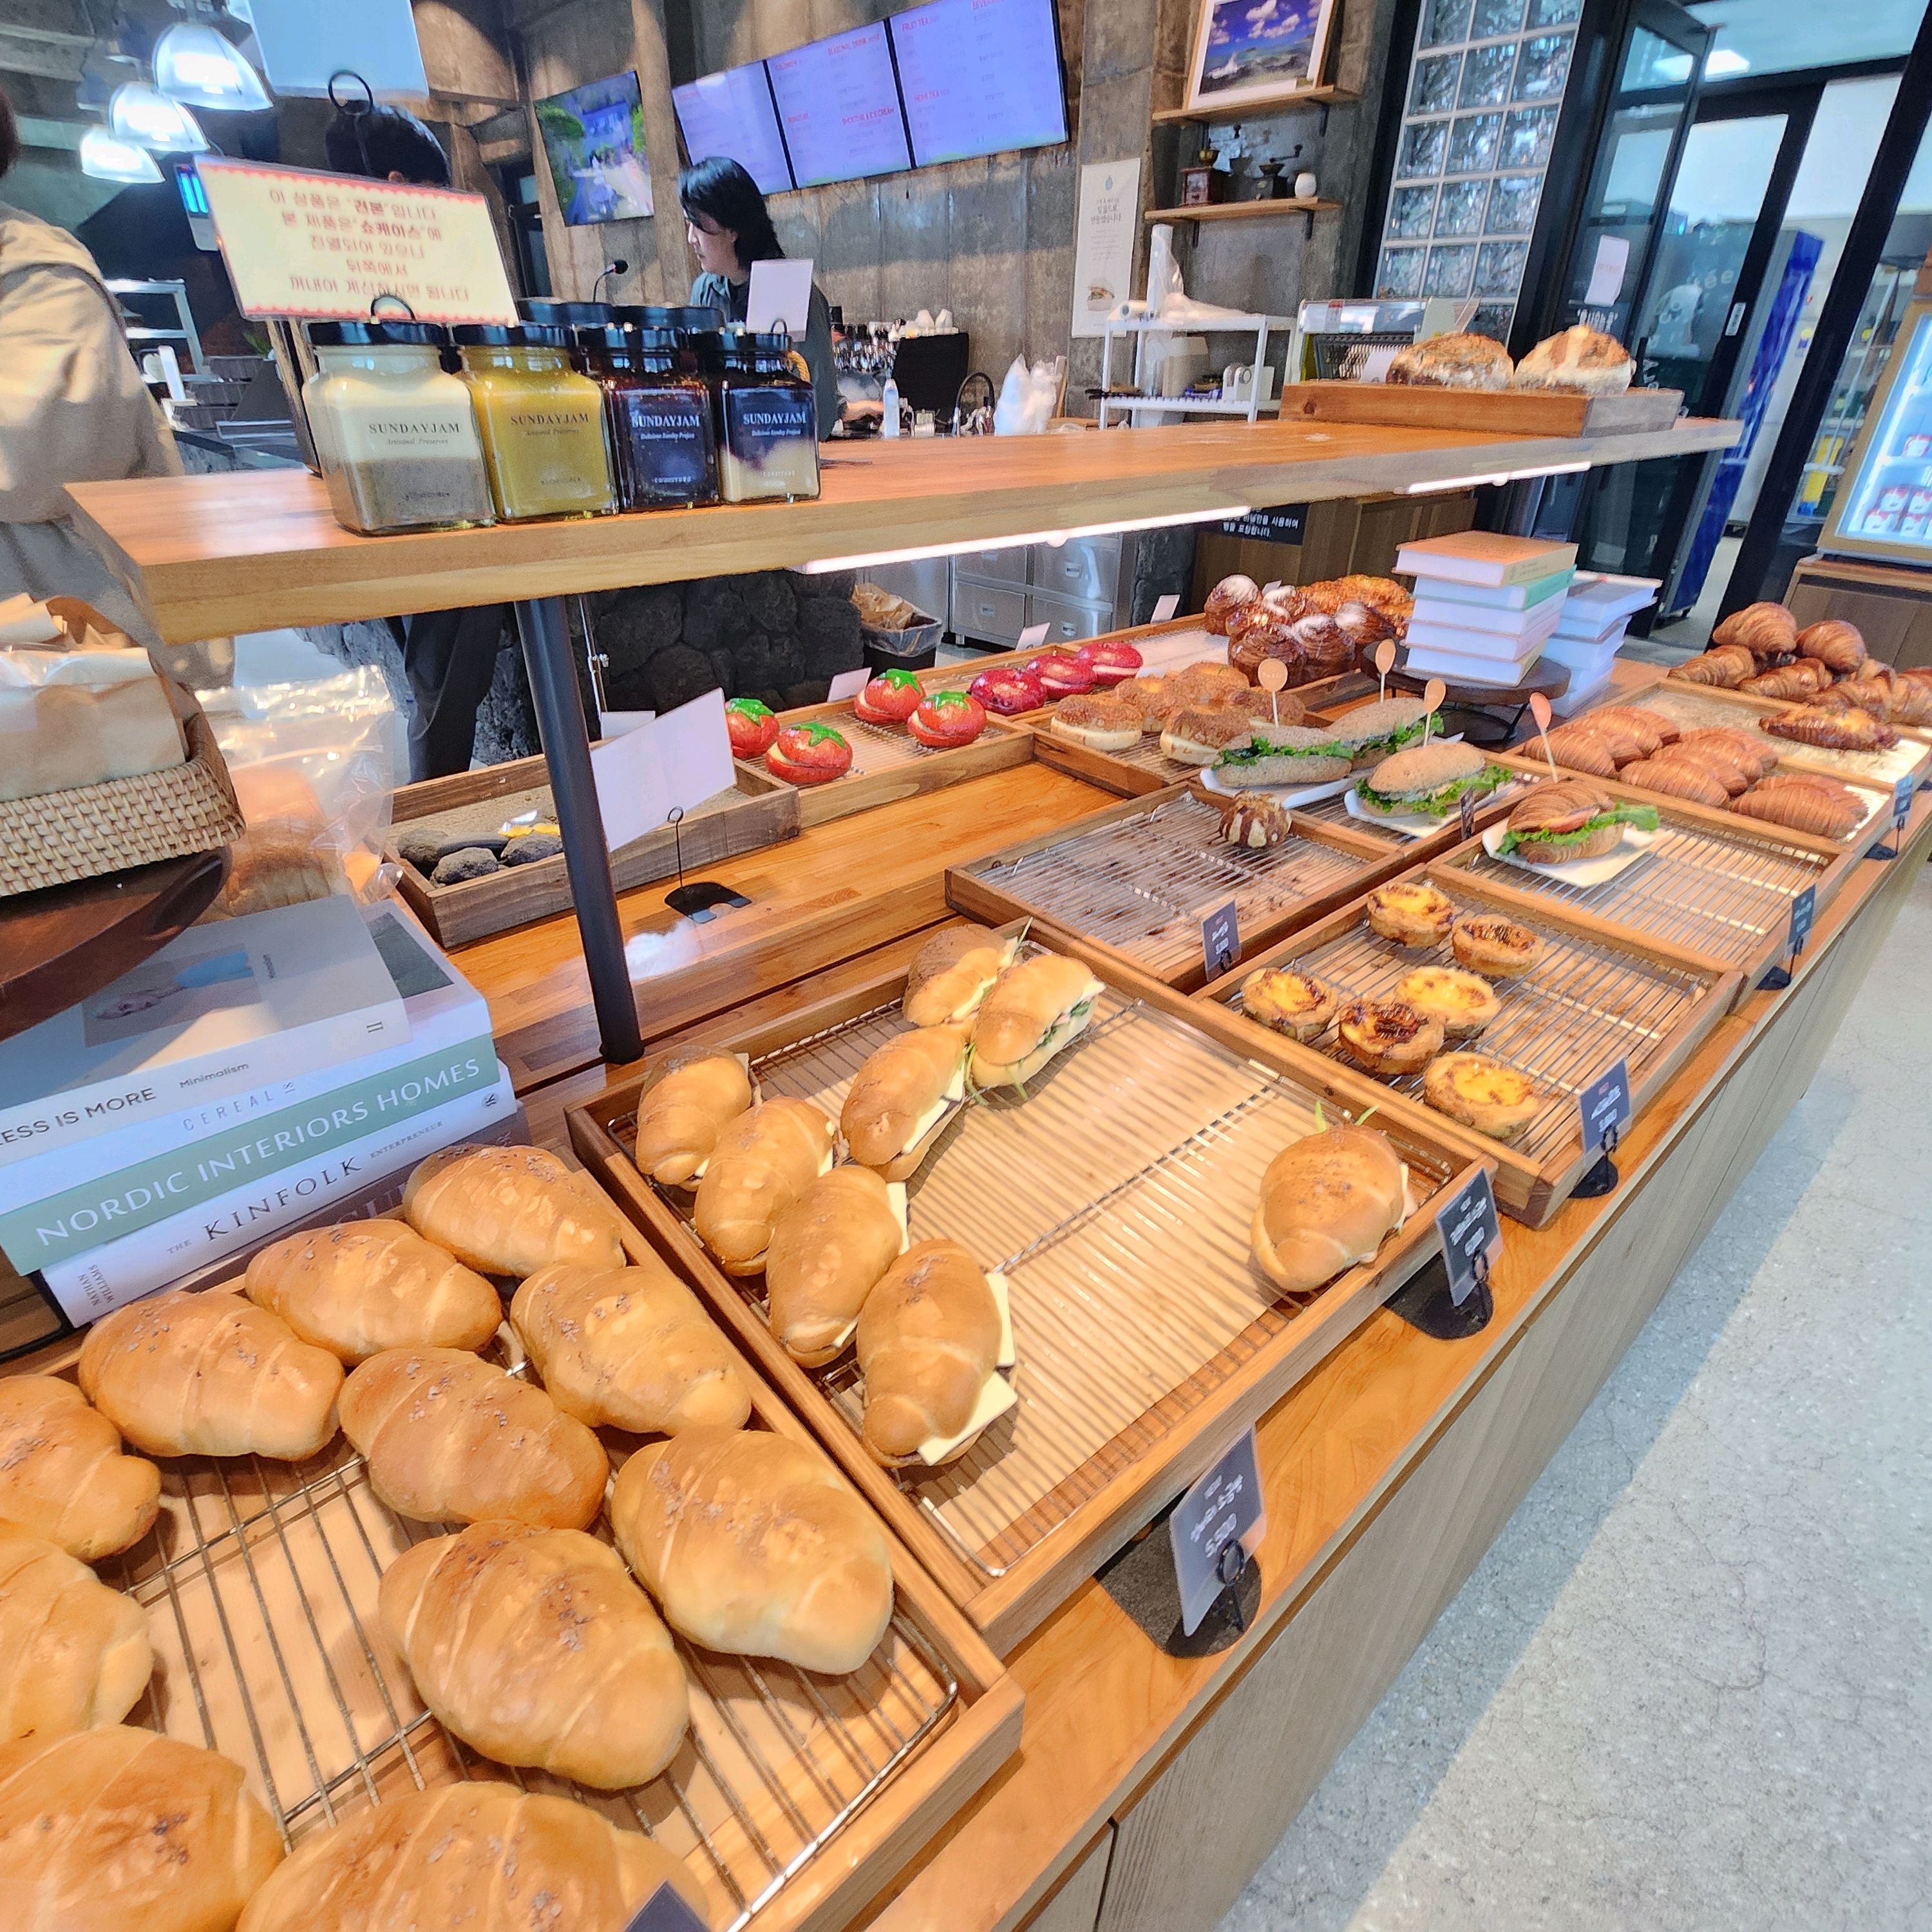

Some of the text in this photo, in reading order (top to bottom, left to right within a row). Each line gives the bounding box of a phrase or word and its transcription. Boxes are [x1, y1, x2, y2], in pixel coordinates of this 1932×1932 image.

[270, 189, 285, 204] 이
[369, 422, 460, 435] SUNDAYJAM
[511, 413, 589, 426] SUNDAYJAM
[632, 415, 700, 428] SUNDAYJAM
[743, 412, 807, 425] SUNDAYJAM
[179, 1063, 249, 1088] Minimalism
[0, 1088, 157, 1146] ESS IS MORE
[183, 1090, 274, 1131] CEREAL
[35, 1058, 480, 1246] NORDIC INTERIORS HOMES
[167, 1239, 192, 1254] THE
[203, 1157, 362, 1242] KINFOLK
[77, 1273, 102, 1307] NATHAN
[88, 1264, 115, 1303] WILLIAMS
